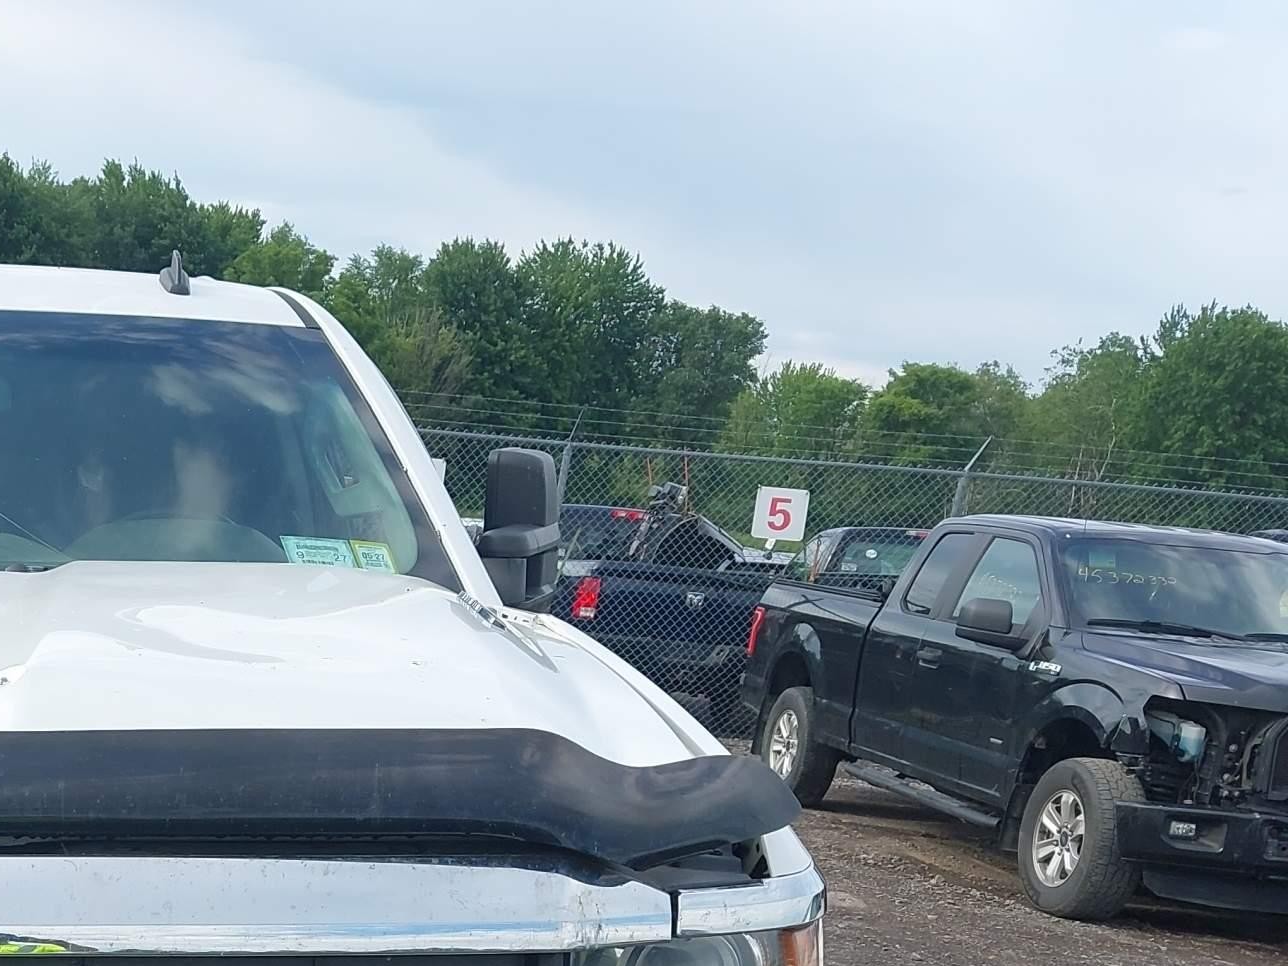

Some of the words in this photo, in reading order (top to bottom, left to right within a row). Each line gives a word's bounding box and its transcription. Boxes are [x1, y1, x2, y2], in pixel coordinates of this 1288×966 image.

[767, 497, 793, 531] 5
[333, 553, 346, 563] 27
[1078, 567, 1177, 586] 45372332
